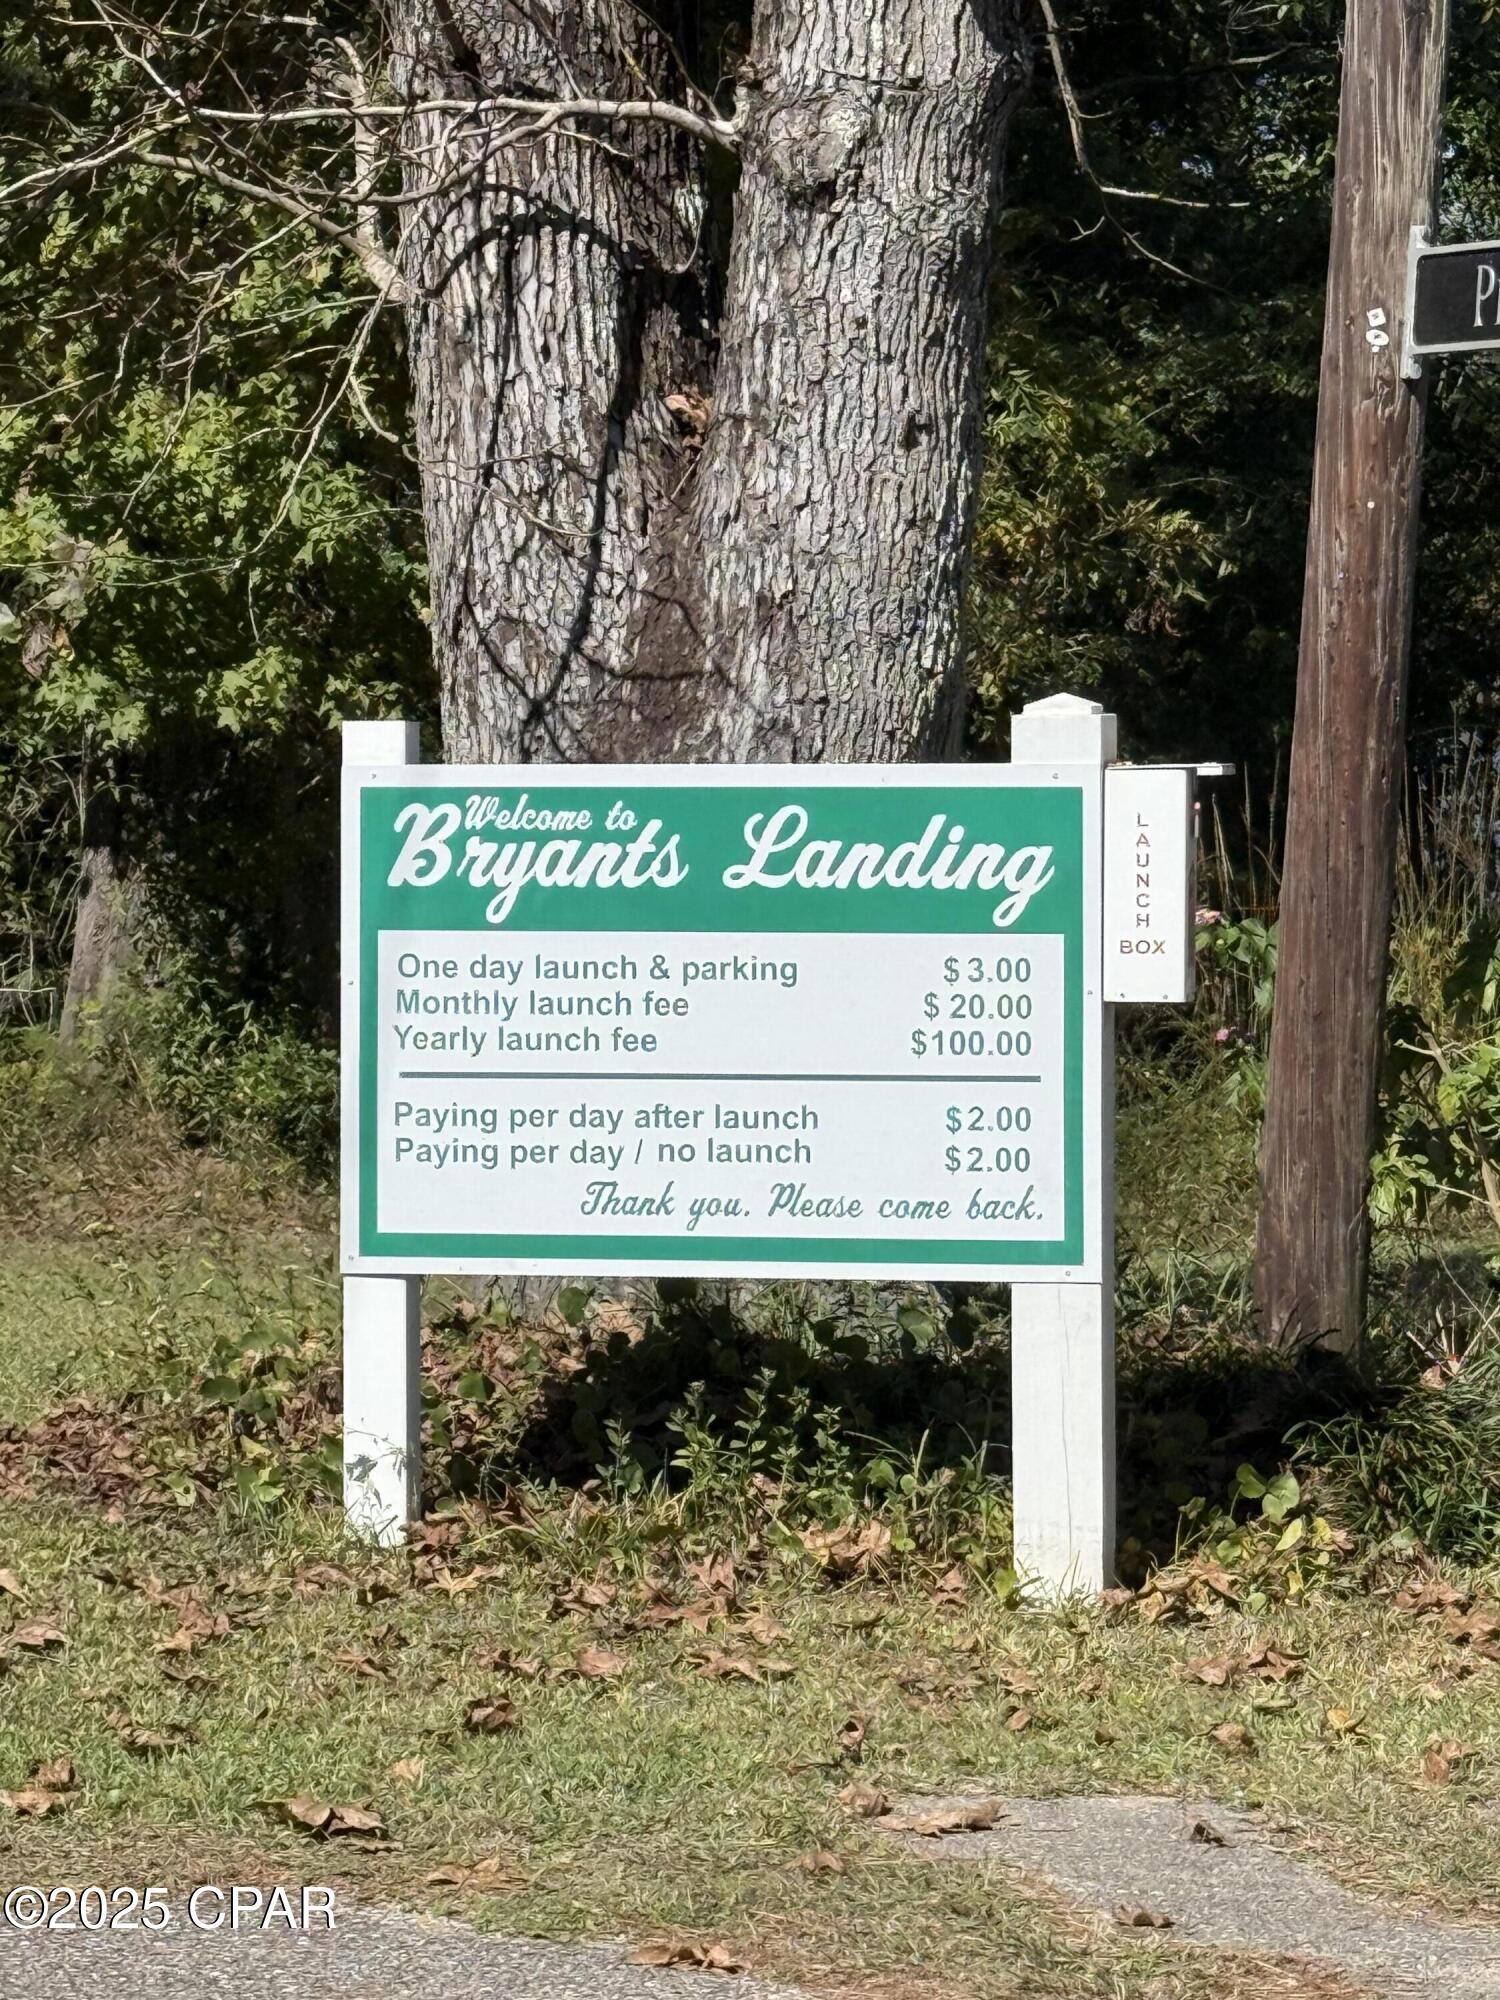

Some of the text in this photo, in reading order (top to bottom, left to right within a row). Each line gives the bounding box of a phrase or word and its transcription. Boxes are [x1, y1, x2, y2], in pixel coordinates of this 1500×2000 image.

[1473, 264, 1500, 327] P
[464, 793, 638, 831] Welcome to
[387, 803, 1056, 927] Bryants Landing
[1136, 812, 1151, 929] LAUNCH
[1119, 939, 1166, 955] BOX
[397, 952, 459, 980] One
[469, 953, 524, 986] day
[535, 953, 637, 980] launch
[649, 954, 671, 980] &
[682, 955, 798, 988] parking
[396, 989, 518, 1022] Monthly
[529, 990, 632, 1017] launch
[642, 990, 689, 1017] fee
[393, 1024, 1032, 1058] Yearly launch fee $100.00
[394, 1102, 1032, 1135] Paying per day after launch $2.00
[395, 1137, 1031, 1176] Paying per day / no launch $2.00
[580, 1180, 1043, 1232] Thank you. Please come back.
